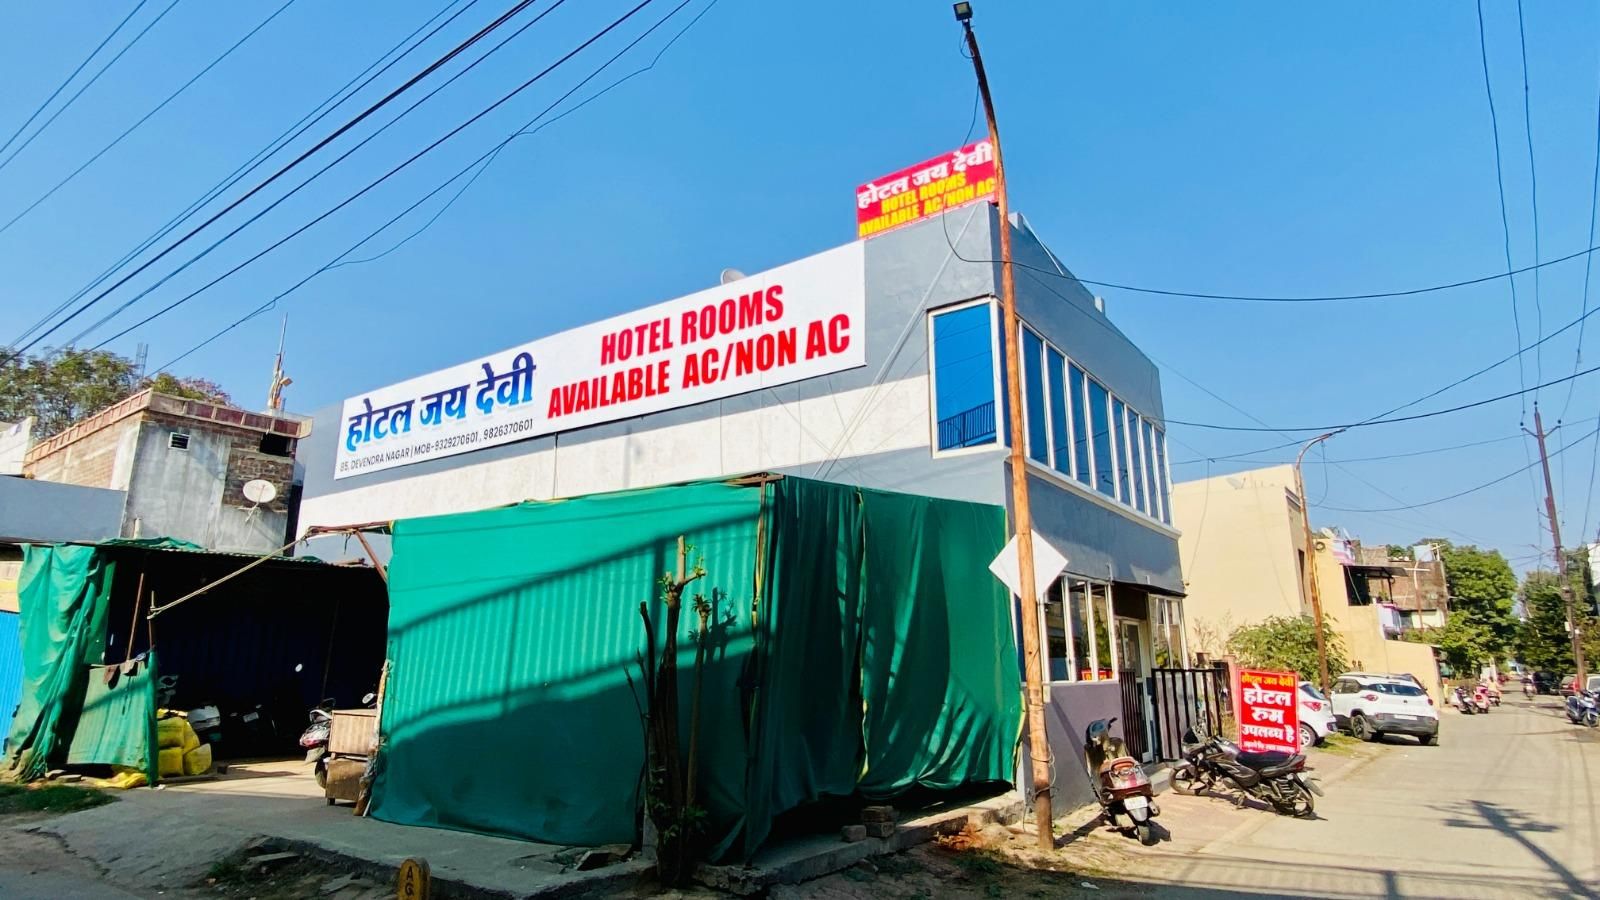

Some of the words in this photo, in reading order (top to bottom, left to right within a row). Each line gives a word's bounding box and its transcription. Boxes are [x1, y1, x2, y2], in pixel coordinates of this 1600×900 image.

[857, 176, 910, 209] होटल
[911, 161, 950, 186] जय
[952, 141, 993, 172] देवी
[881, 189, 918, 214] HOTEL
[919, 171, 966, 202] ROOMS
[858, 203, 920, 238] AVAILABLE
[976, 177, 996, 197] AC
[600, 317, 674, 366] HOTEL
[681, 285, 784, 345] ROOMS
[547, 360, 671, 419] AVAILABLE
[682, 327, 797, 389] AC/NON
[805, 313, 851, 360] AC
[346, 398, 415, 452] होटल
[420, 384, 470, 426] जय
[476, 352, 537, 415] देवी
[350, 453, 385, 471] DEVENDRA
[386, 446, 410, 461] NAGAR
[483, 418, 533, 440] 9826370601
[1243, 682, 1292, 706] होटल
[1241, 724, 1283, 740] उपलब्ध
[1284, 724, 1294, 743] है
